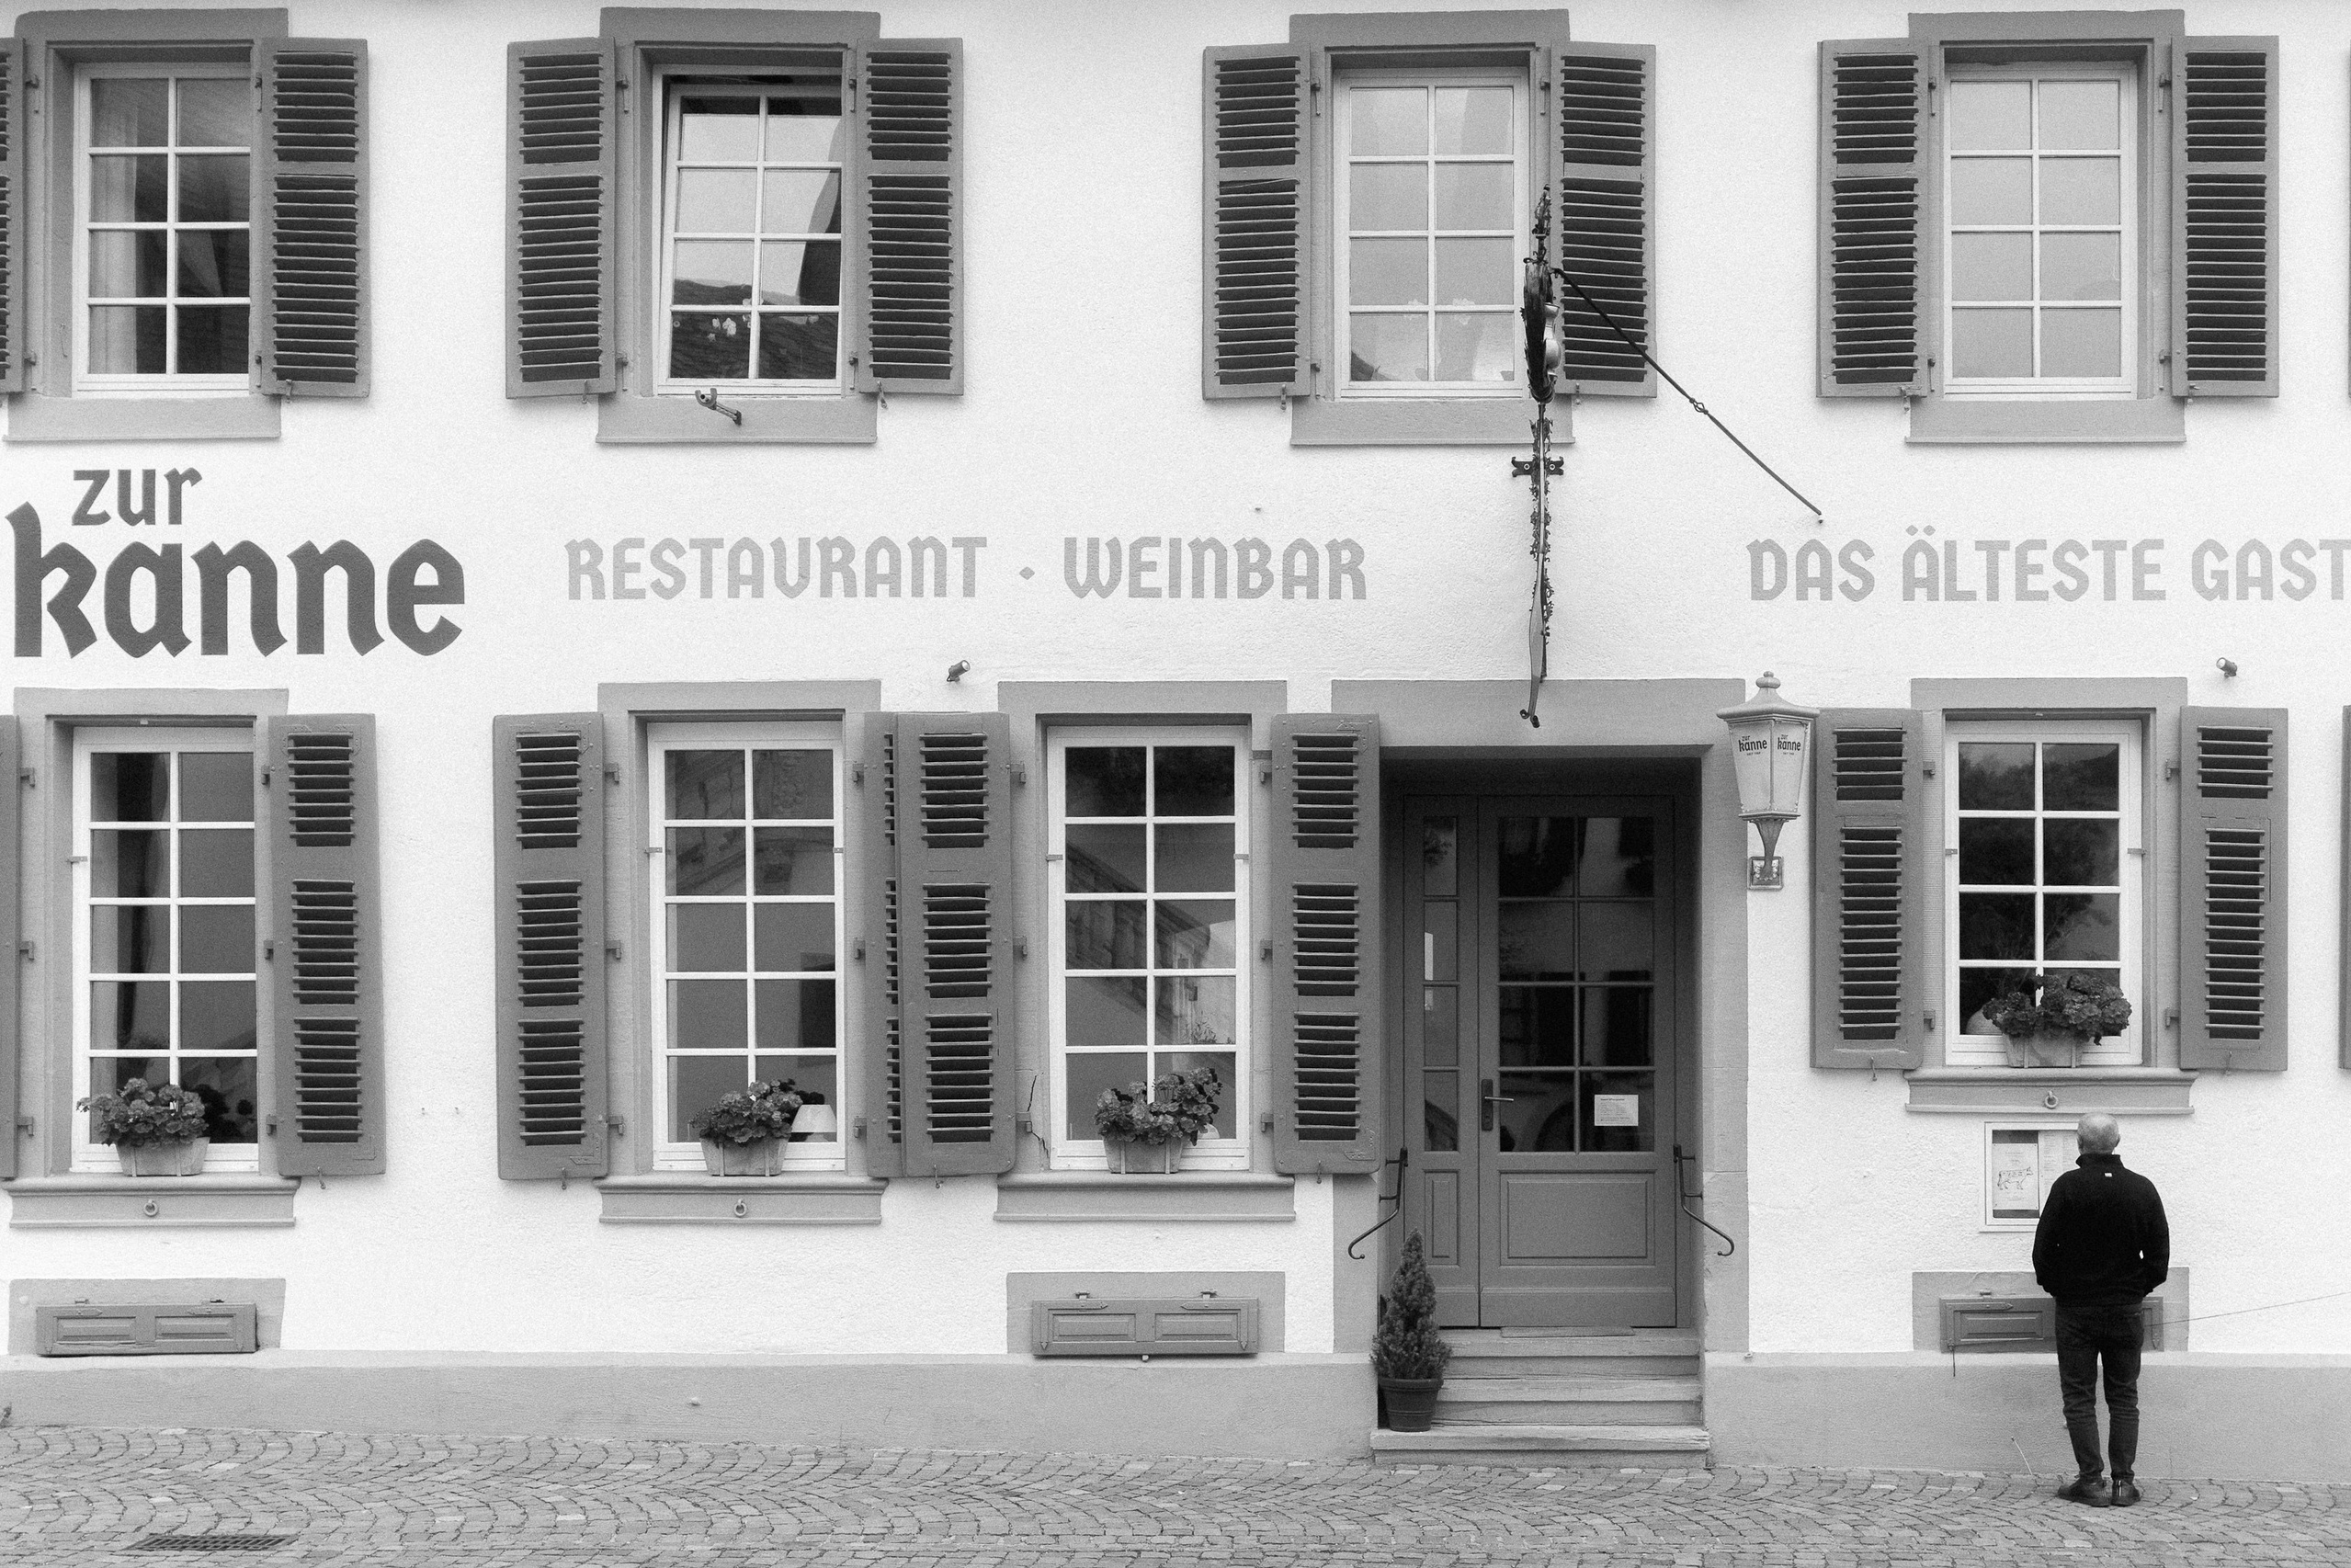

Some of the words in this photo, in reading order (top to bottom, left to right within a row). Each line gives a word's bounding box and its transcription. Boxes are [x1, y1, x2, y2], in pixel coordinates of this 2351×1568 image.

[73, 468, 202, 527] zur
[6, 502, 465, 660] kanne
[563, 535, 988, 601] RESTAURANT
[1063, 535, 1368, 601] WEINBAR
[1745, 538, 1876, 603] DAS
[1902, 524, 2166, 603] ÄLTESTE
[2191, 538, 2351, 602] GAST
[1738, 740, 1767, 752] kanne
[1777, 737, 1801, 751] kanne
